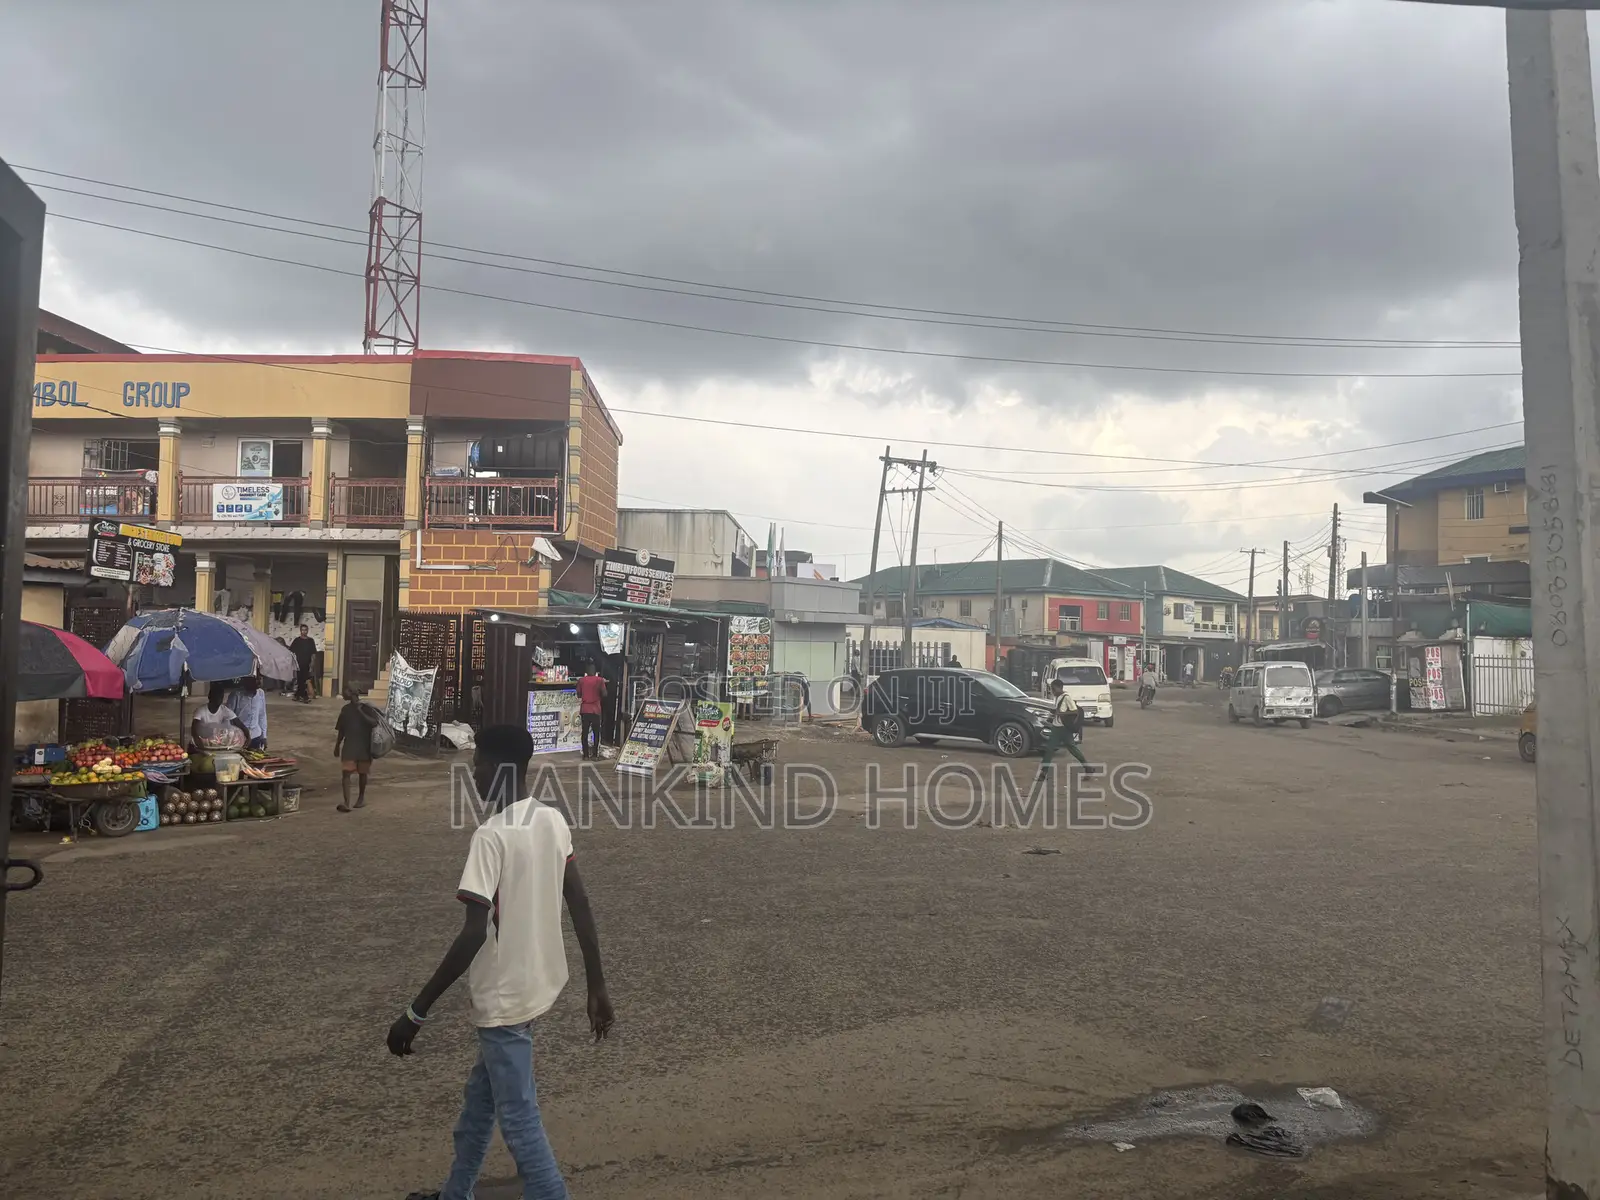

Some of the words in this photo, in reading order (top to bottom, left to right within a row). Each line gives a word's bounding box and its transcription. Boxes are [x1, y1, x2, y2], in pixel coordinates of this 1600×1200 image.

[122, 381, 191, 408] GROUP
[236, 486, 270, 494] TIMELESS
[132, 538, 155, 550] GROCERY
[155, 543, 171, 553] STORE
[1426, 647, 1440, 658] POS
[1427, 668, 1441, 680] POS
[1409, 679, 1422, 687] POS
